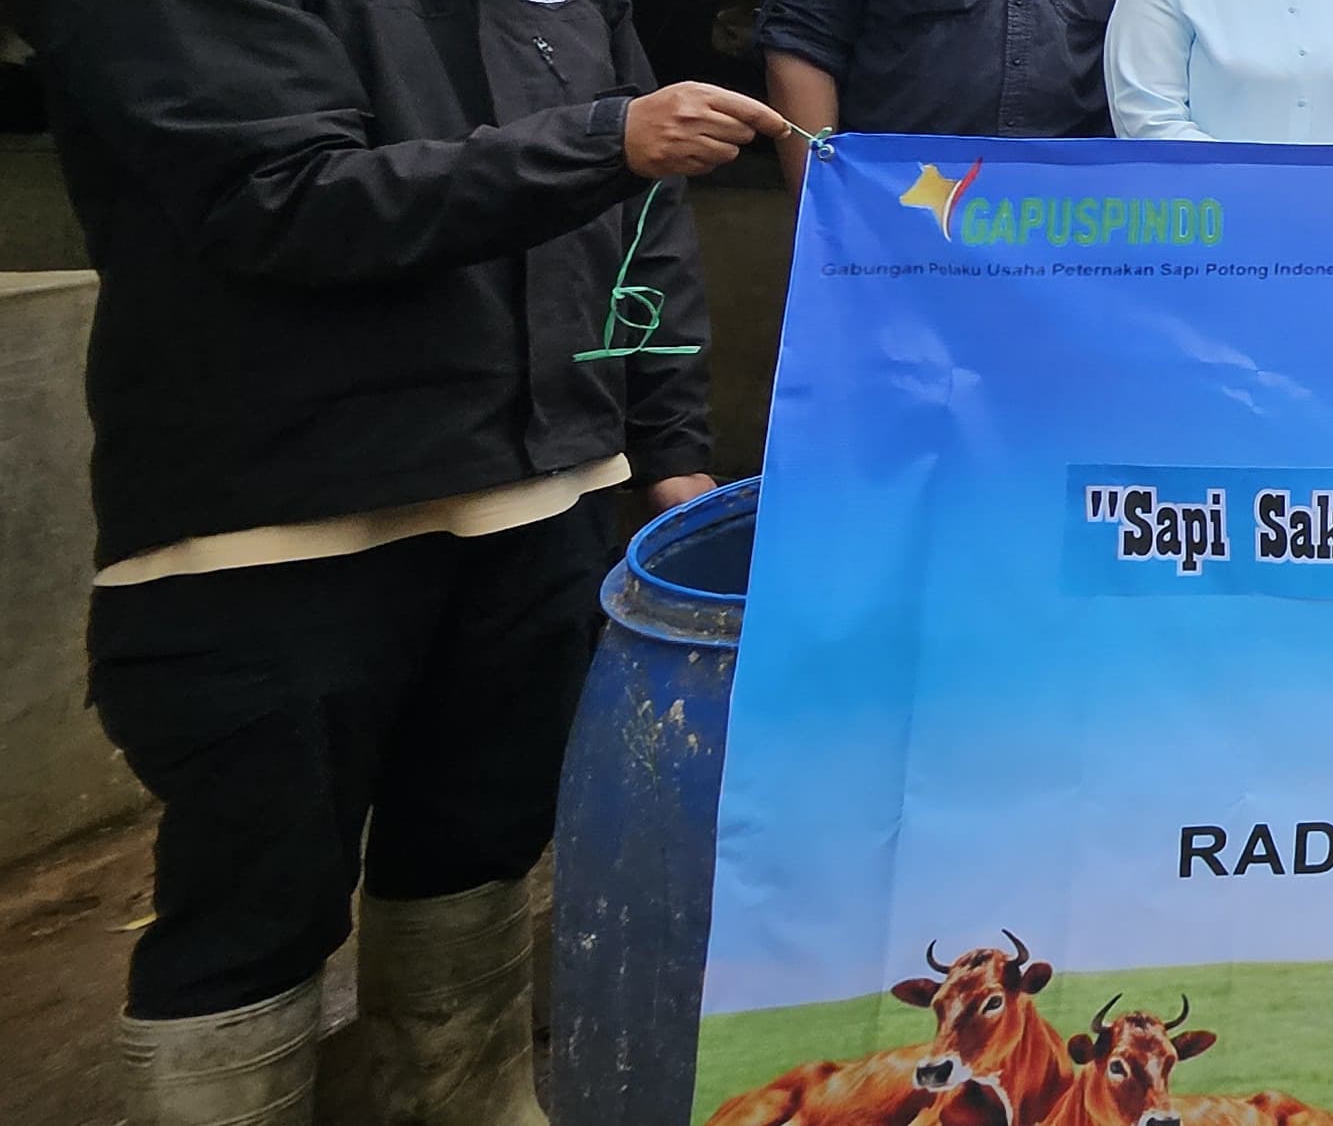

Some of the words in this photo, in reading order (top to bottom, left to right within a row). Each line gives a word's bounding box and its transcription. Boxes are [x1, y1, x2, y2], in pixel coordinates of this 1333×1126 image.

[962, 197, 1224, 247] GAPUSPINDO
[822, 262, 924, 279] Gabungan
[928, 263, 981, 276] Pelaku
[987, 263, 1046, 276] Usaha
[1053, 263, 1154, 277] Peternakan
[1160, 262, 1199, 278] Sapi
[1206, 263, 1268, 279] Potong
